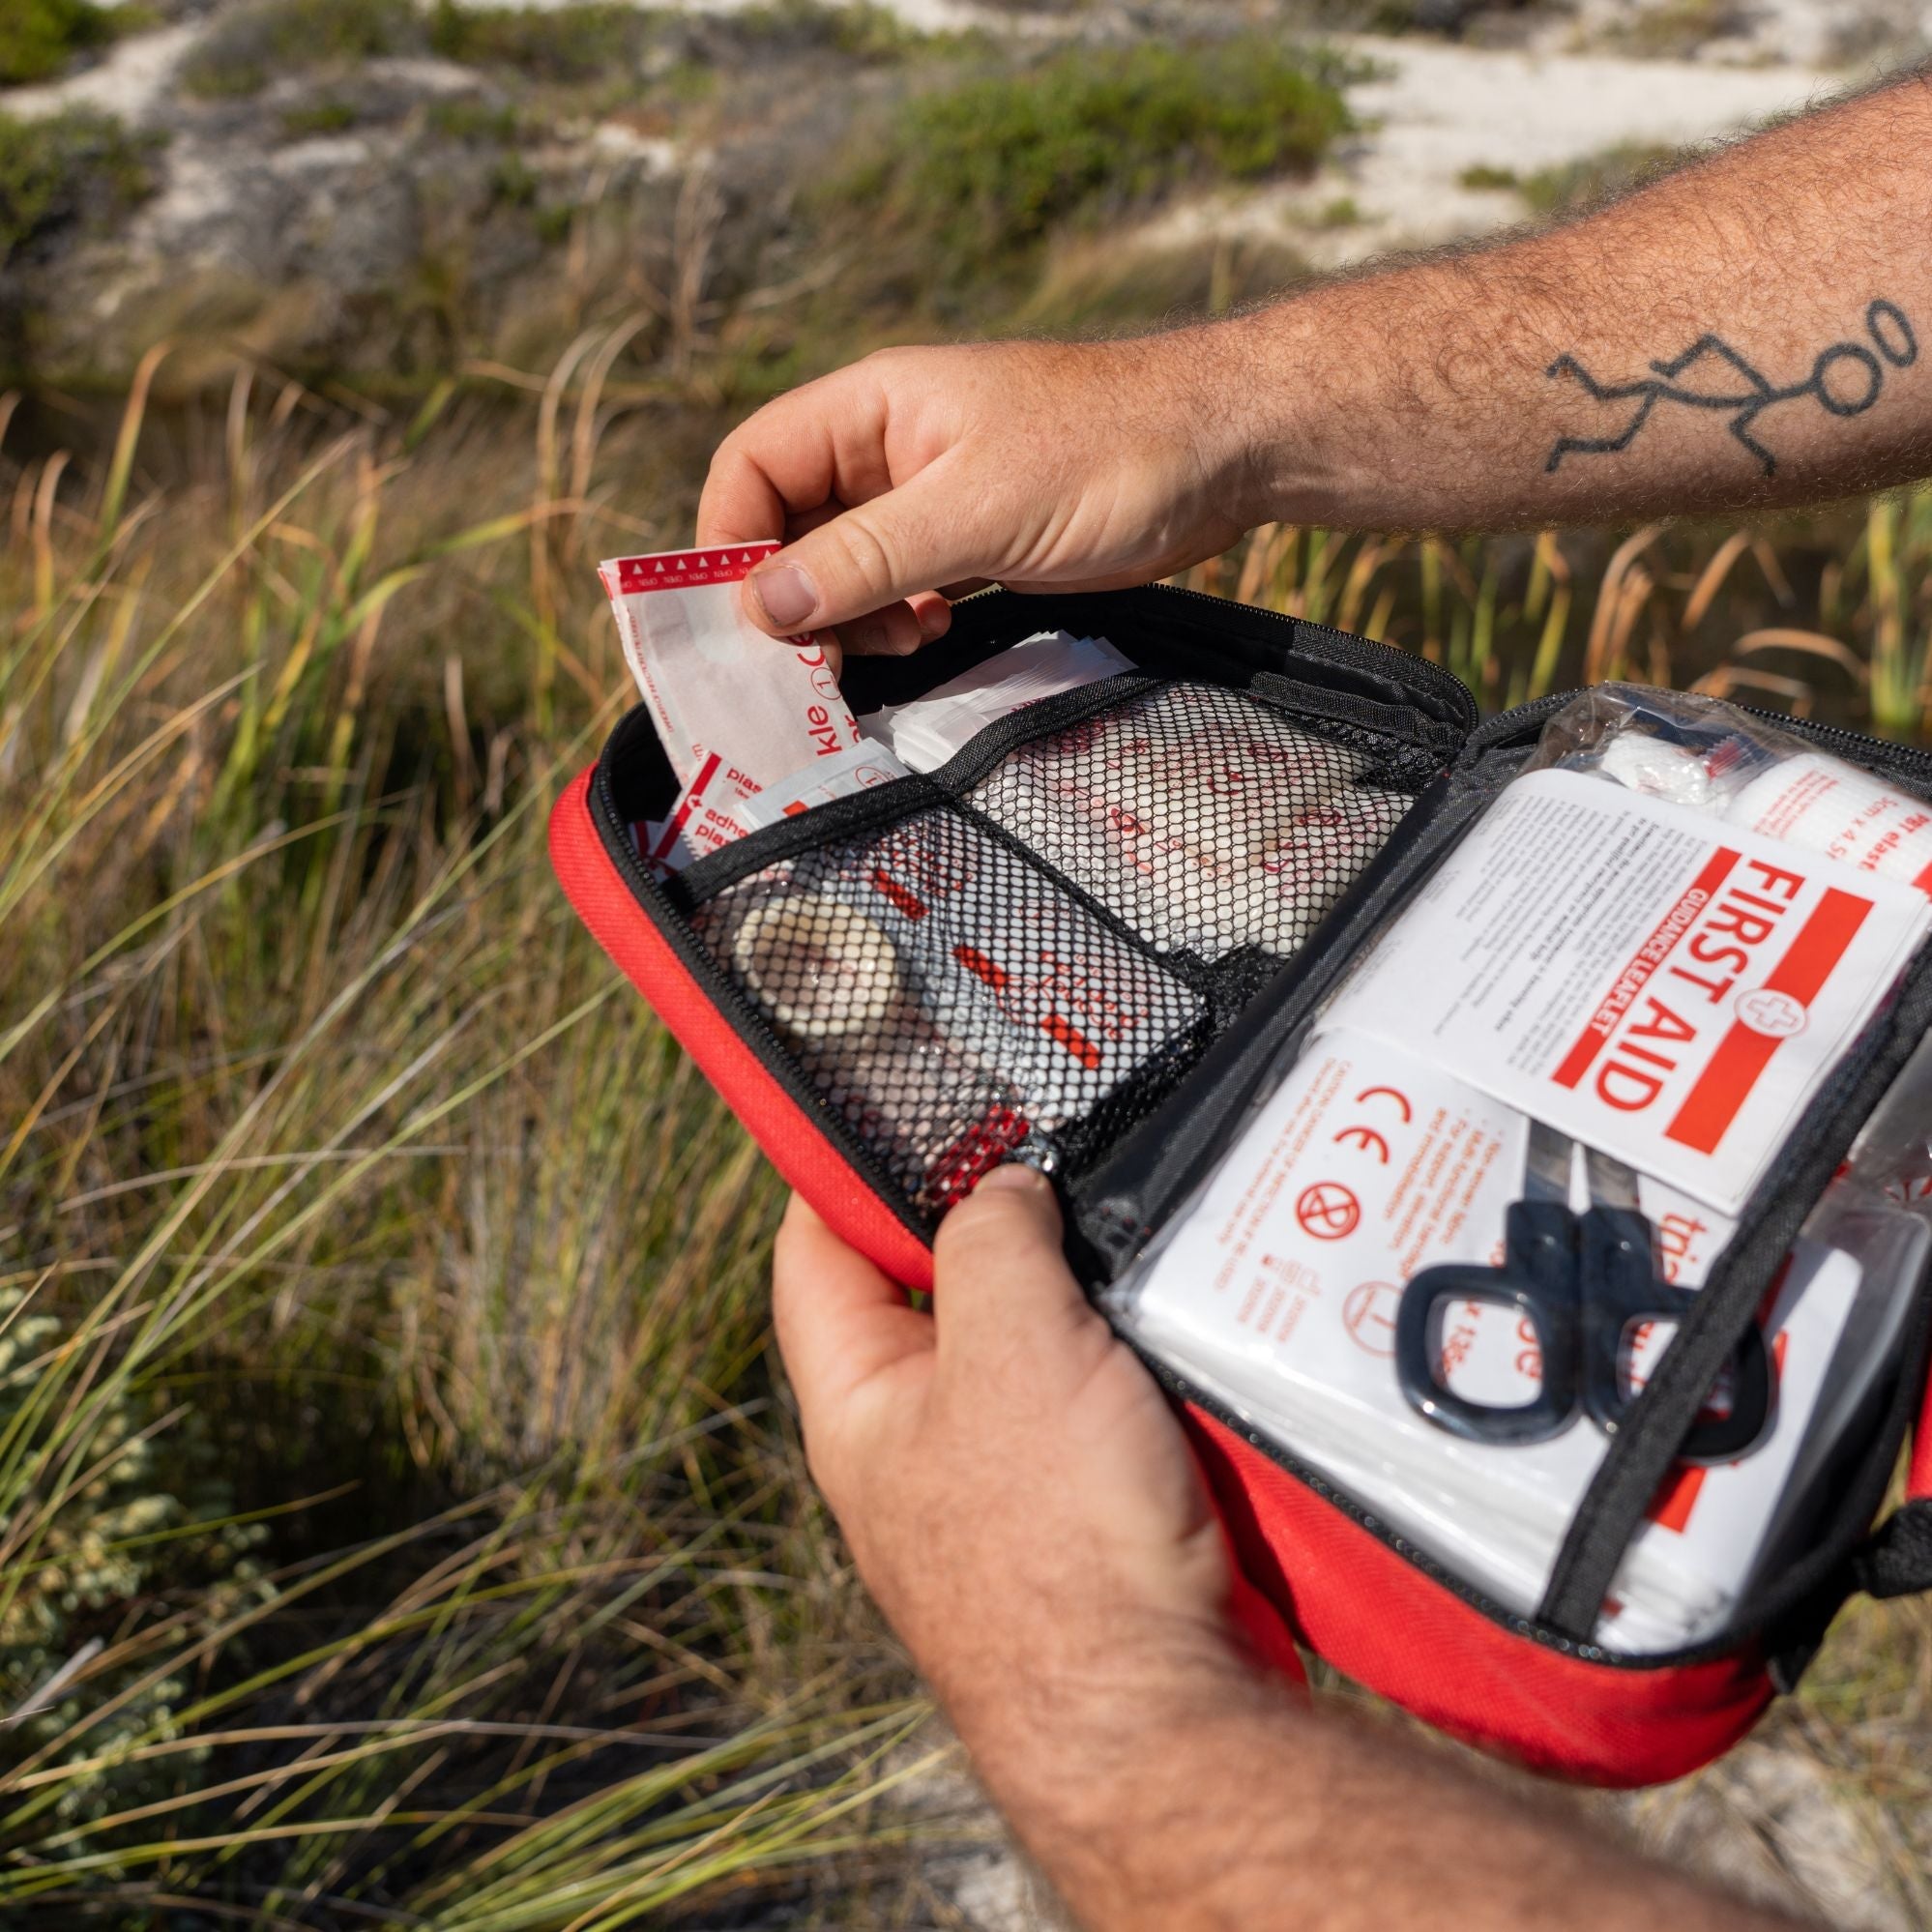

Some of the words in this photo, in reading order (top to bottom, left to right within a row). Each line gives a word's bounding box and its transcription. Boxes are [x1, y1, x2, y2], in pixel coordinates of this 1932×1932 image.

[1859, 831, 1901, 872] elast
[1639, 886, 1710, 964] GUIDANCE
[1669, 859, 1806, 1004] FIRST
[1589, 957, 1654, 1037] LEAFLET
[1595, 997, 1698, 1112] AID
